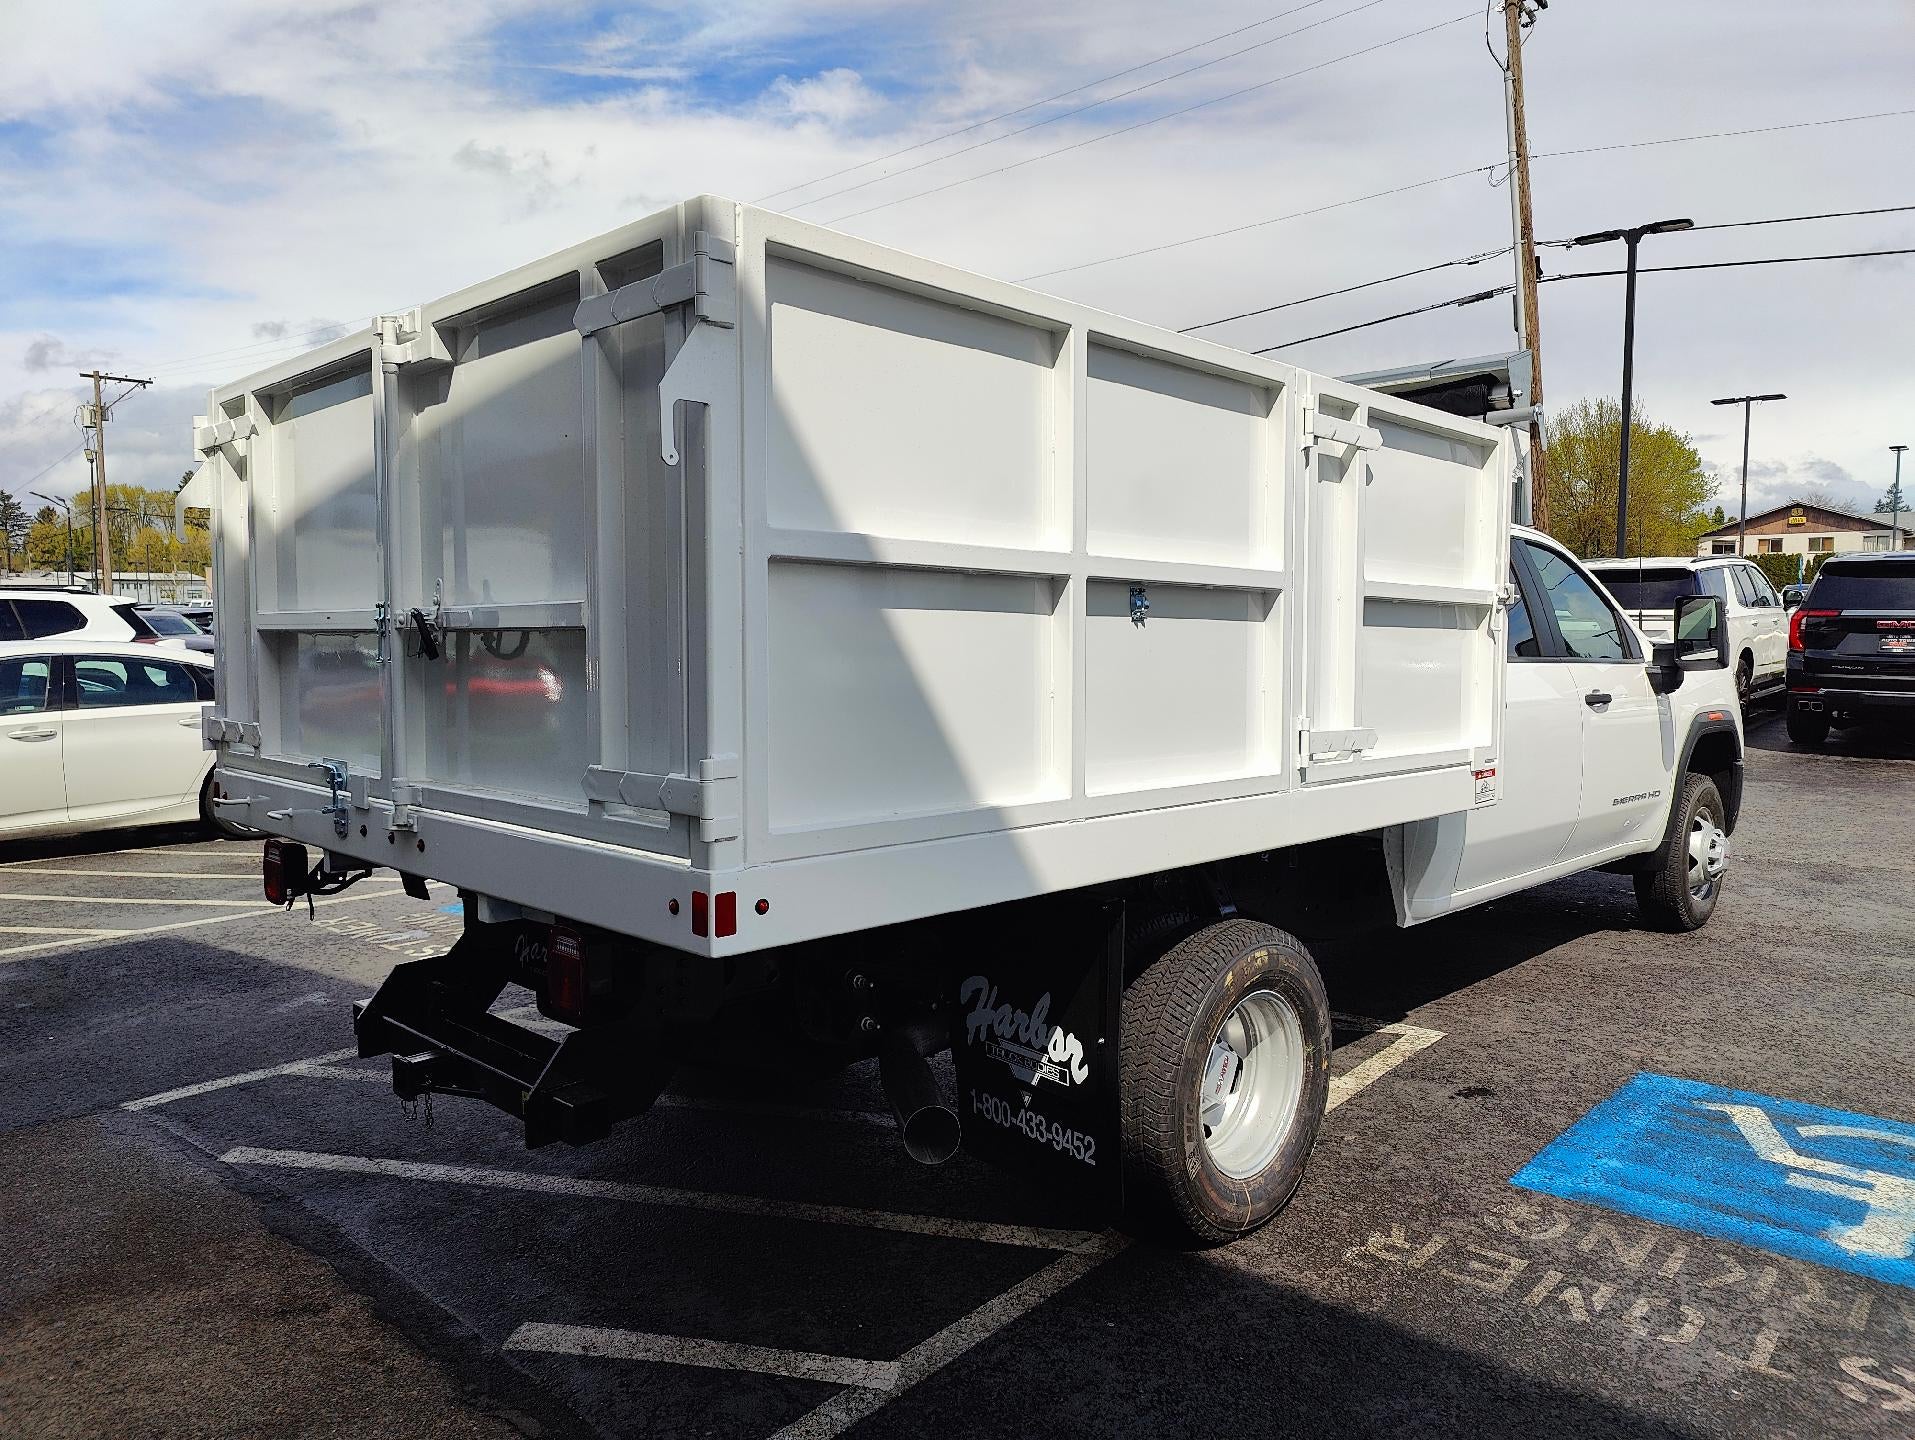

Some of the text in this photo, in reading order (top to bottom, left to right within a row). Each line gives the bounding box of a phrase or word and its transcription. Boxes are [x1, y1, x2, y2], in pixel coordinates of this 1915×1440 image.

[1612, 790, 1661, 806] SIERRA HD
[970, 1089, 1096, 1166] 1-800-433-9452
